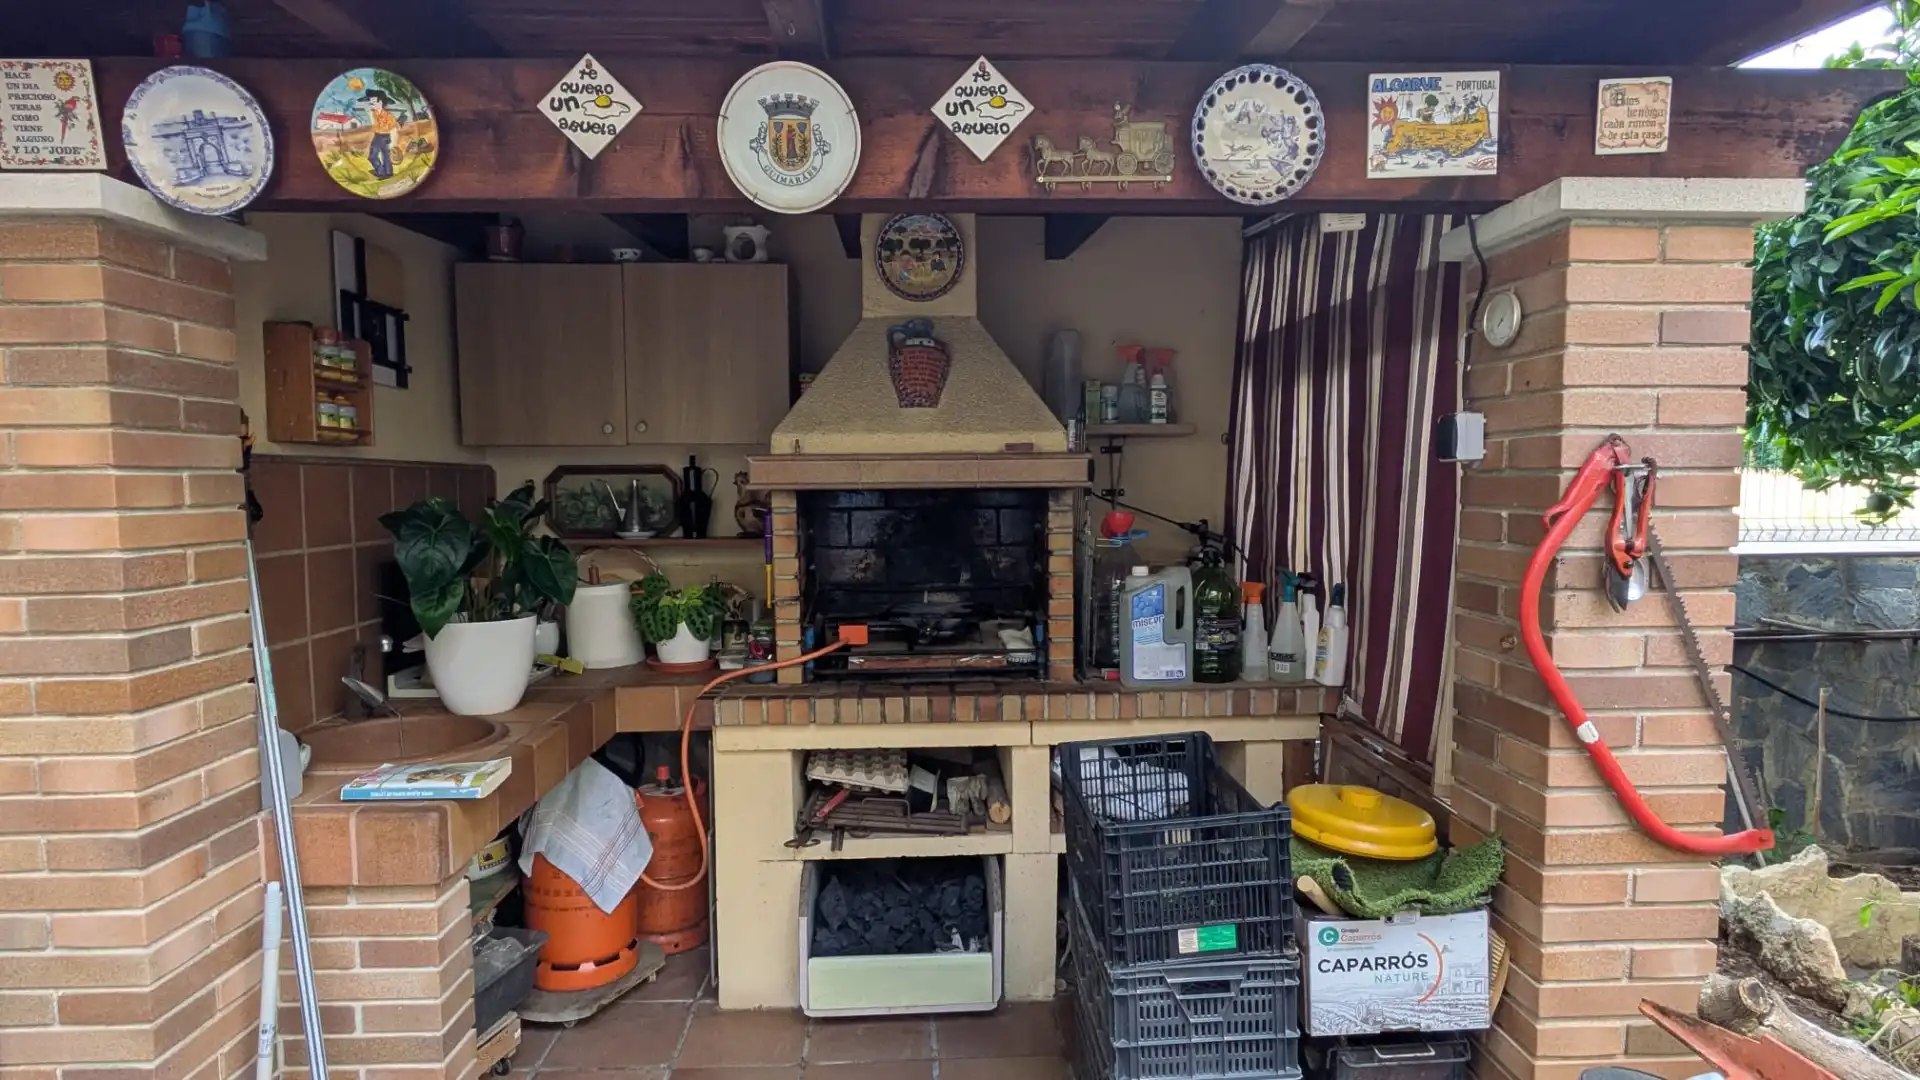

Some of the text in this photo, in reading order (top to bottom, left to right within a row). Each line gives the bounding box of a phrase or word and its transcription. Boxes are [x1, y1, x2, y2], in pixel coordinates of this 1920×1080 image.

[4, 71, 31, 80] HACE
[579, 68, 598, 80] te
[972, 70, 991, 82] te
[6, 82, 40, 90] UN DIA
[1371, 76, 1442, 93] ALGARVE
[1455, 79, 1497, 91] PORTUGAL
[7, 92, 57, 101] PRECIOSO
[10, 103, 42, 111] VERAS
[11, 114, 40, 122] COMO
[13, 124, 43, 133] VIENE
[16, 135, 55, 143] ALGUNO
[12, 146, 20, 154] Y
[23, 146, 40, 155] LO
[1340, 932, 1382, 942] Caparrós
[1317, 950, 1429, 974] CAPARRÓS
[1374, 971, 1429, 983] NATURE
